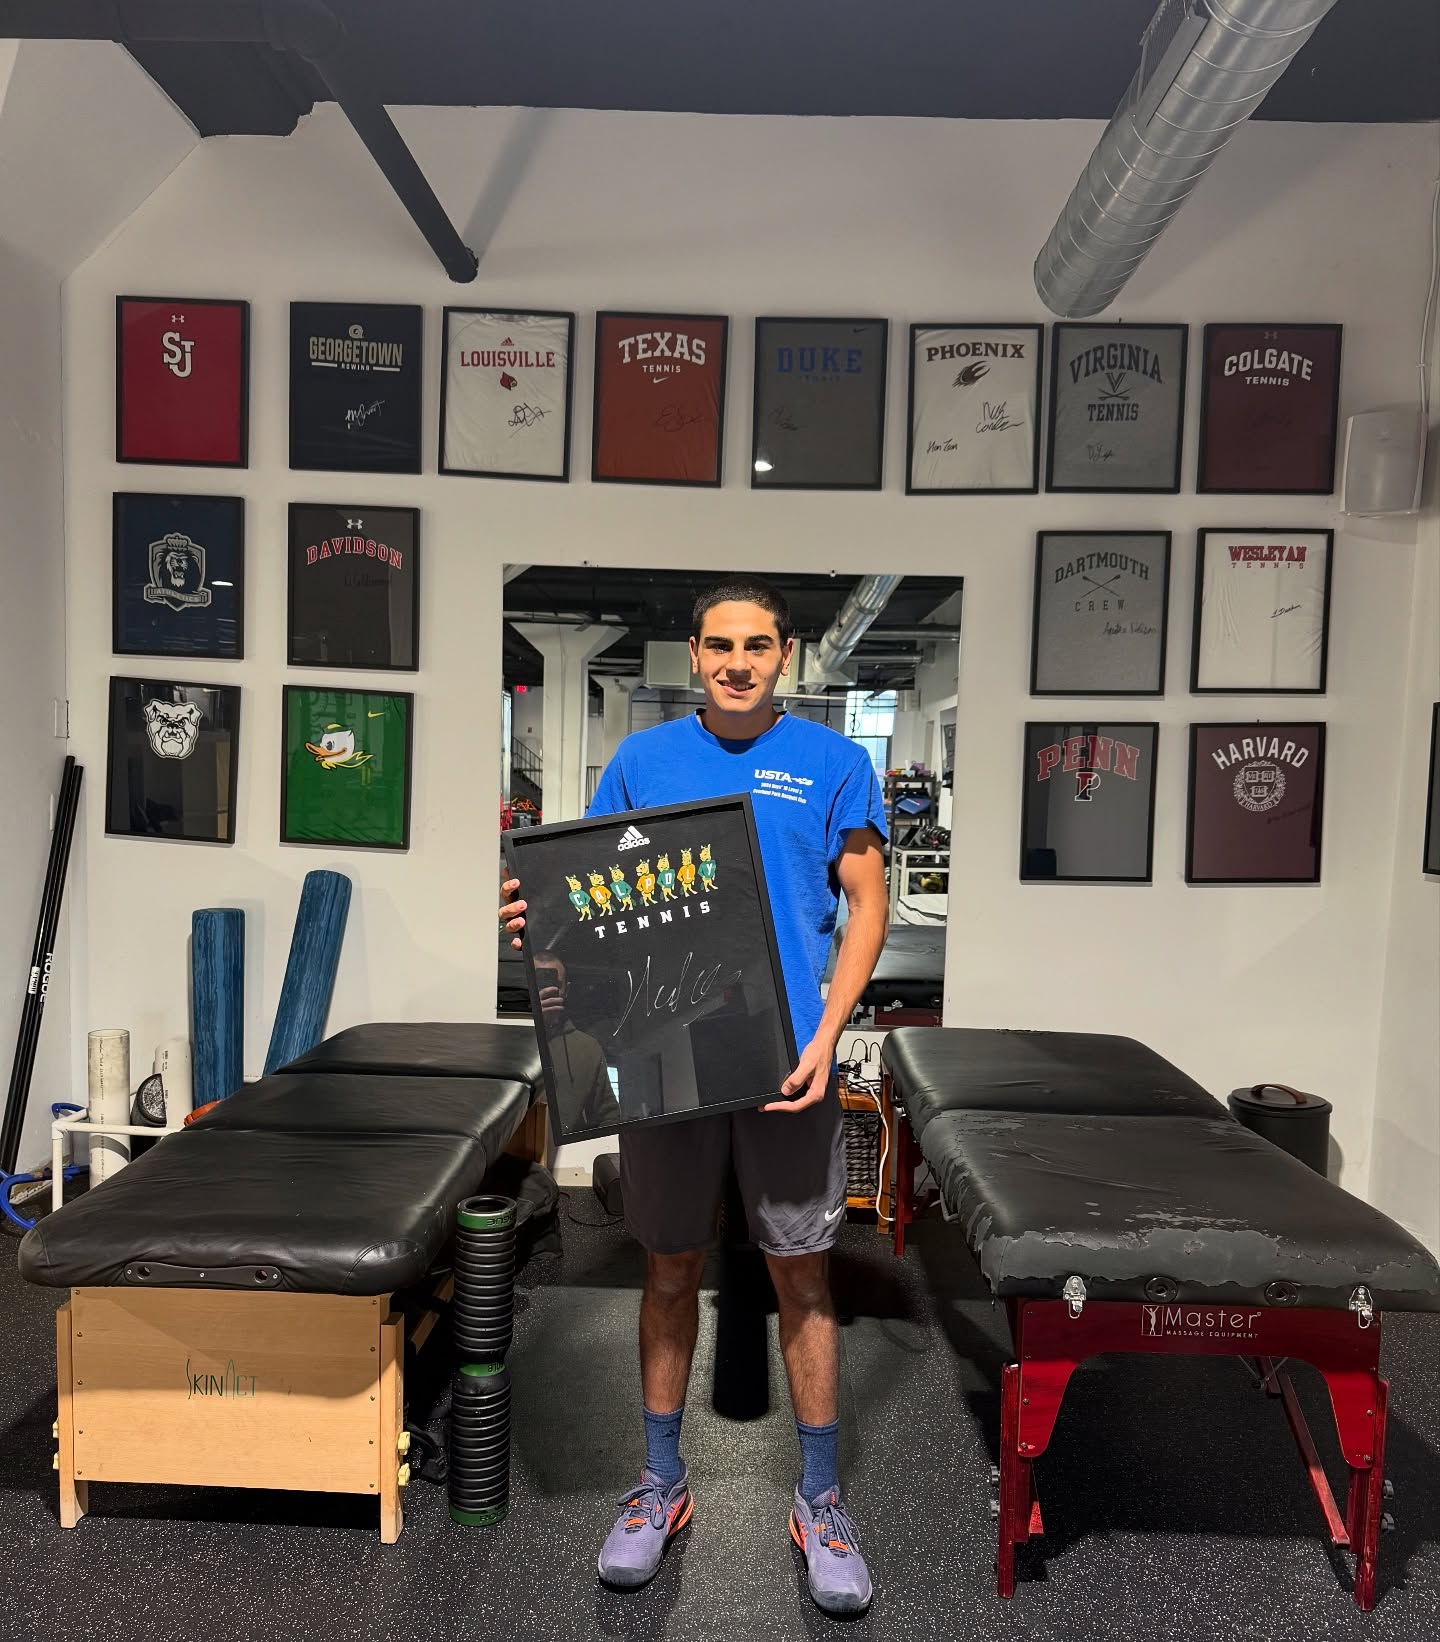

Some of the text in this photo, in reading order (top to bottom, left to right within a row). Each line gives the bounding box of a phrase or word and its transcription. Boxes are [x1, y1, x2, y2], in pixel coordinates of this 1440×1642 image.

[309, 336, 403, 366] GEORGETOWN
[460, 350, 556, 368] LOUISVILLE
[618, 331, 706, 366] TEXAS
[926, 341, 1025, 362] PHOENIX
[341, 363, 370, 371] ROWING
[642, 365, 682, 373] TENNIS
[776, 347, 863, 374] DUKE
[1069, 343, 1163, 384] VIRGINIA
[1223, 348, 1313, 381] COLGATE
[1245, 376, 1290, 387] TENNIS
[1087, 403, 1139, 422] TENNIS
[306, 536, 403, 570] DAVIDSON
[1228, 545, 1308, 563] WESLEYAN
[1055, 552, 1150, 584] DARTMOUTH
[1231, 562, 1305, 570] TENNIS
[1074, 600, 1125, 612] CREW
[1036, 735, 1141, 782] PENN
[1211, 736, 1310, 770] HARVARD
[754, 769, 792, 783] USTA
[1074, 771, 1101, 802] P
[617, 836, 650, 851] adidas
[573, 862, 713, 906] CAL POLY
[594, 900, 711, 939] TENNIS
[1165, 1306, 1258, 1329] Master
[1166, 1329, 1259, 1339] MASSAGE EQUIPMENT
